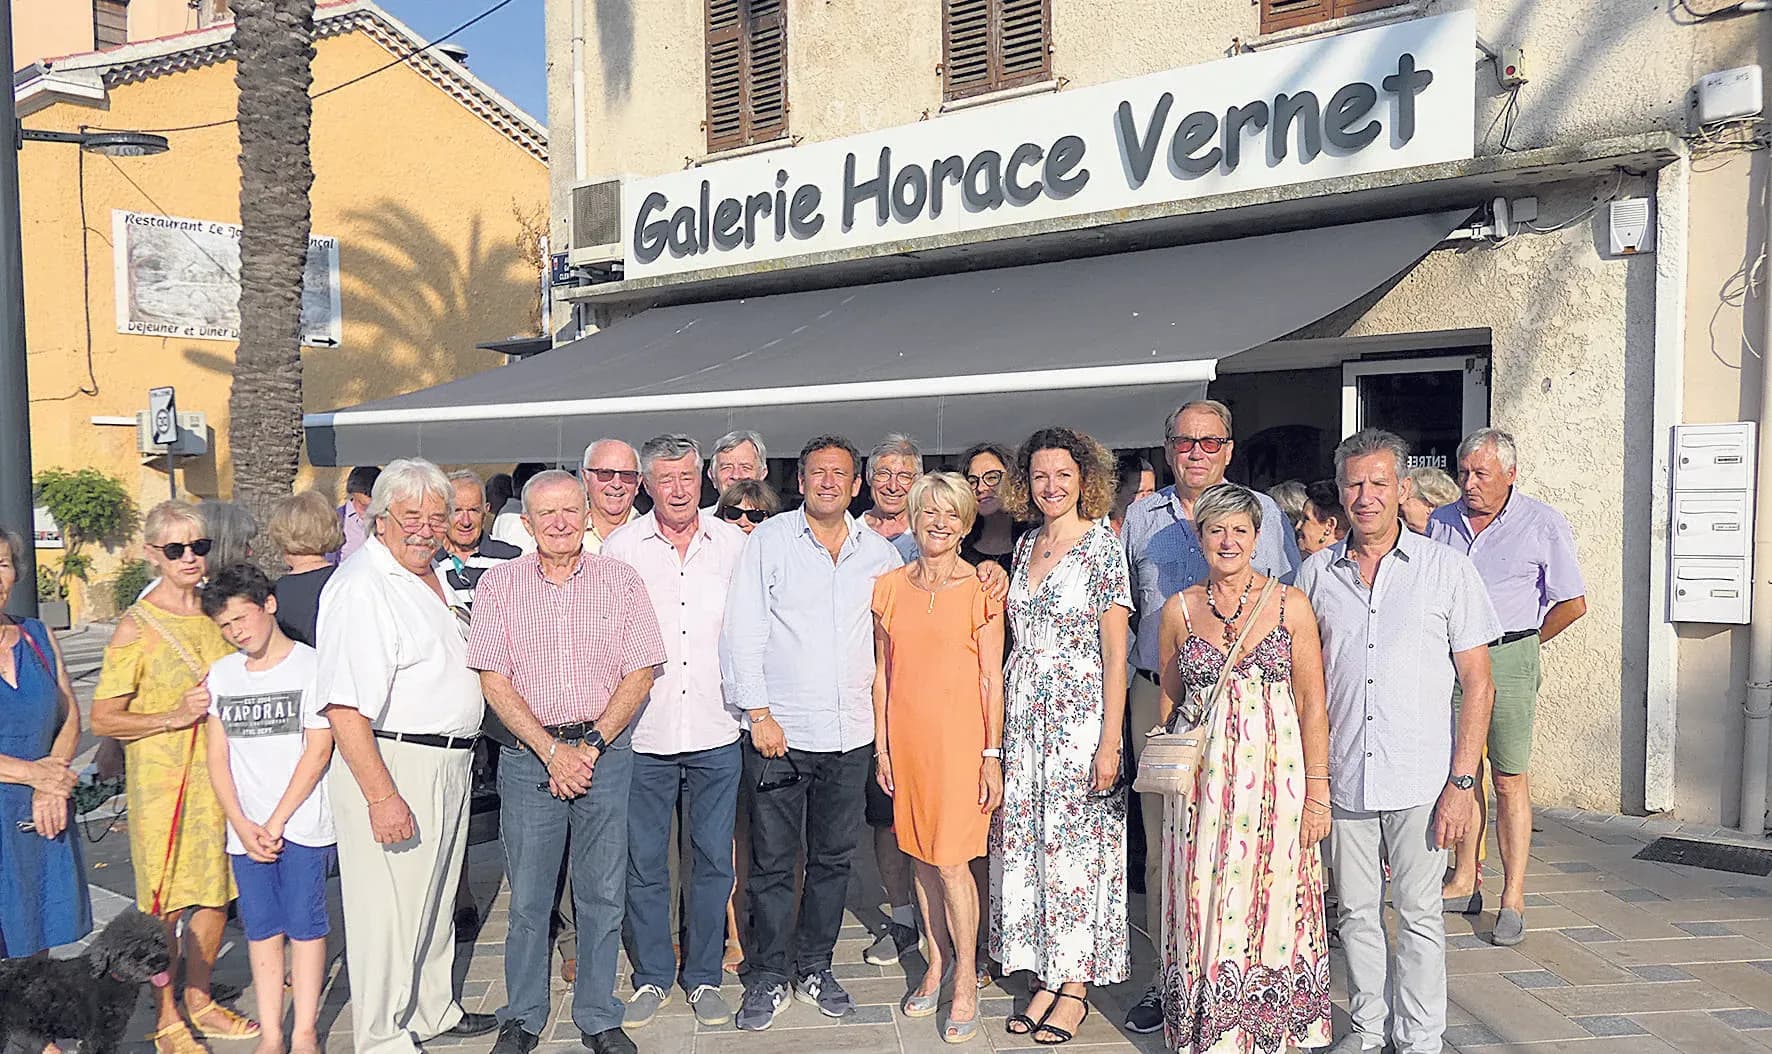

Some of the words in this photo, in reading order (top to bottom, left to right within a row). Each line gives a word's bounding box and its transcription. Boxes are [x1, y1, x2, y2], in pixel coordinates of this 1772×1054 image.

[633, 169, 825, 264] Galerie
[841, 135, 1090, 234] Horace
[1113, 53, 1433, 190] Vernet
[125, 213, 203, 232] Restaurant
[209, 223, 223, 235] Le
[184, 326, 194, 336] et
[221, 701, 296, 722] KAPORAL
